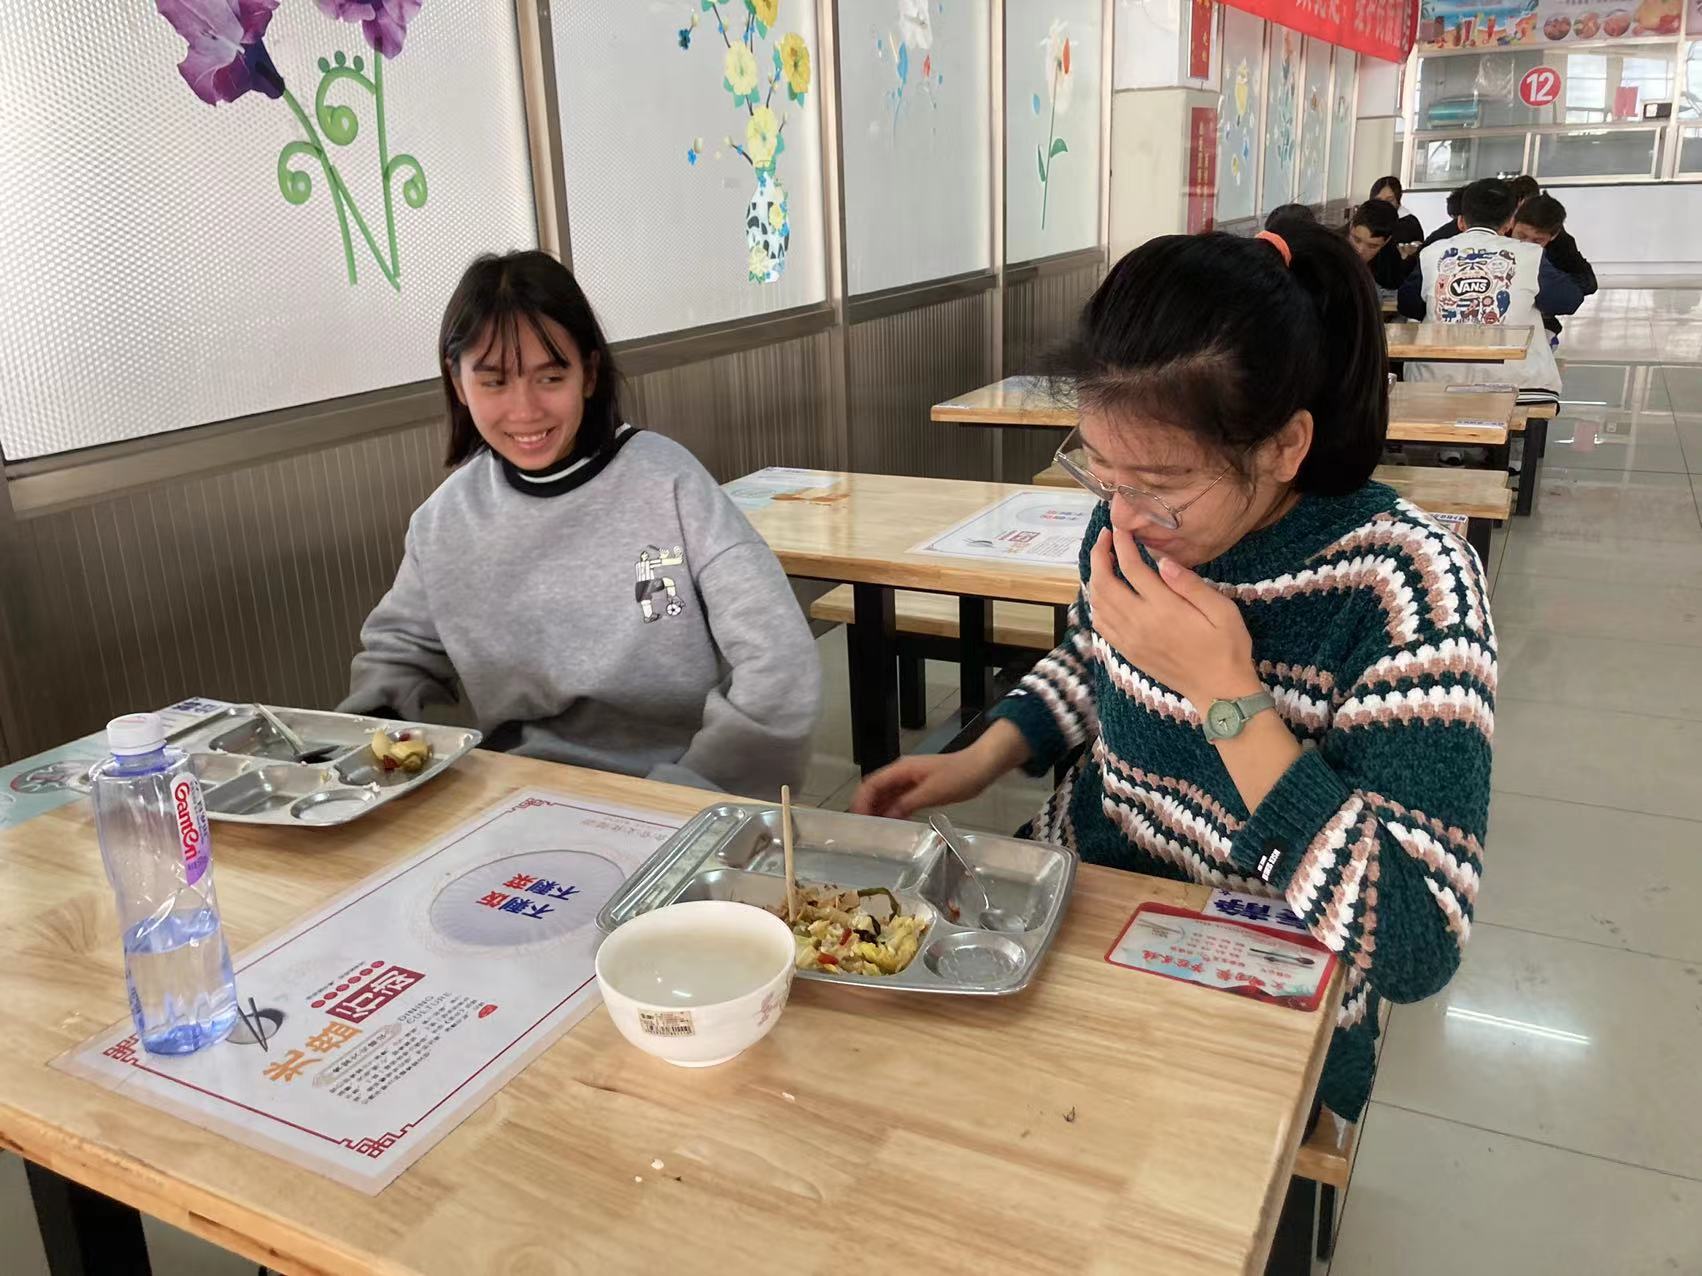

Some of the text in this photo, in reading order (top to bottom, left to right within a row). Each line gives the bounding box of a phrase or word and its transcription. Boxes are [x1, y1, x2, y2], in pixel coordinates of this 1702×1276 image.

[1526, 72, 1554, 101] 12
[1451, 278, 1490, 295] VANS
[503, 872, 581, 901] 不剩菜
[475, 890, 555, 920] 不剩饭
[398, 994, 436, 1023] DINING
